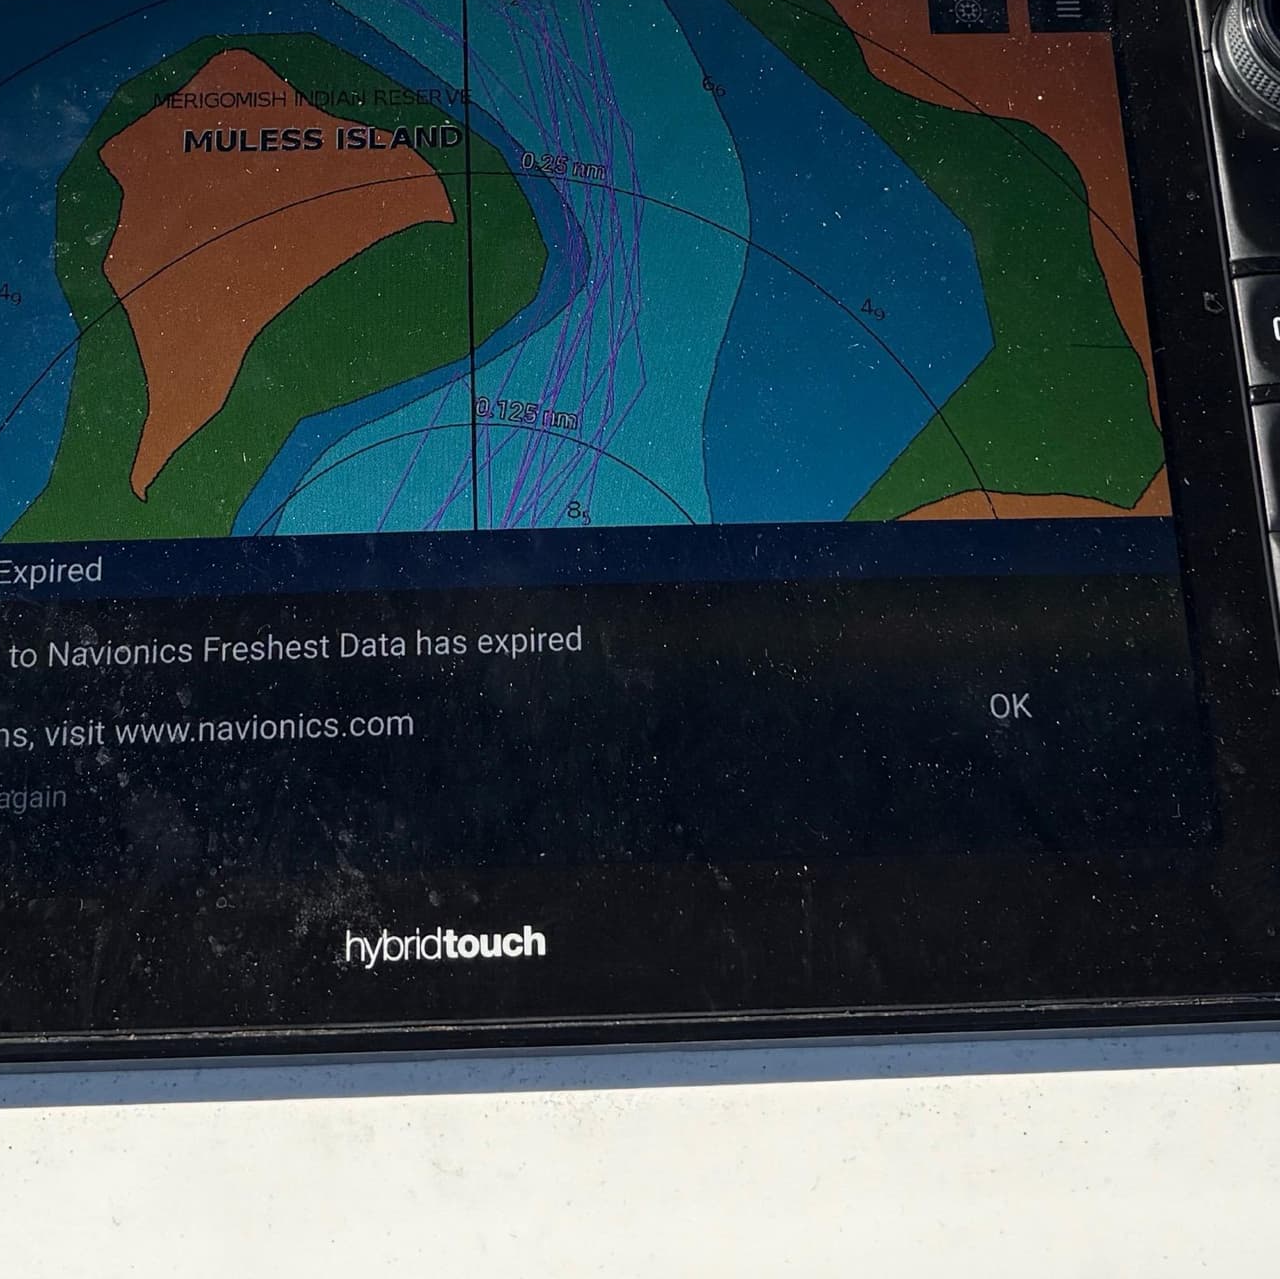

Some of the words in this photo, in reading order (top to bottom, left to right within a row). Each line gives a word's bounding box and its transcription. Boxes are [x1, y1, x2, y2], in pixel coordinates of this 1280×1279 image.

[154, 91, 287, 110] MERIGOMISH
[294, 91, 367, 108] INDIAN
[372, 89, 472, 108] RESERVE
[183, 128, 323, 153] MULESS
[335, 125, 465, 150] ISLAND
[521, 152, 568, 174] 0.25
[571, 162, 606, 180] nm
[475, 397, 538, 423] 0.125
[542, 410, 578, 430] nm
[9, 644, 38, 668] to
[48, 639, 193, 668] Navionics
[204, 634, 330, 662] Freshest
[341, 632, 406, 657] Data
[417, 630, 467, 655] has
[477, 626, 582, 659] expired
[989, 692, 1032, 719] OK
[46, 721, 105, 747] visit
[116, 713, 414, 743] www.navionics.com
[346, 925, 546, 968] hybridtouch
